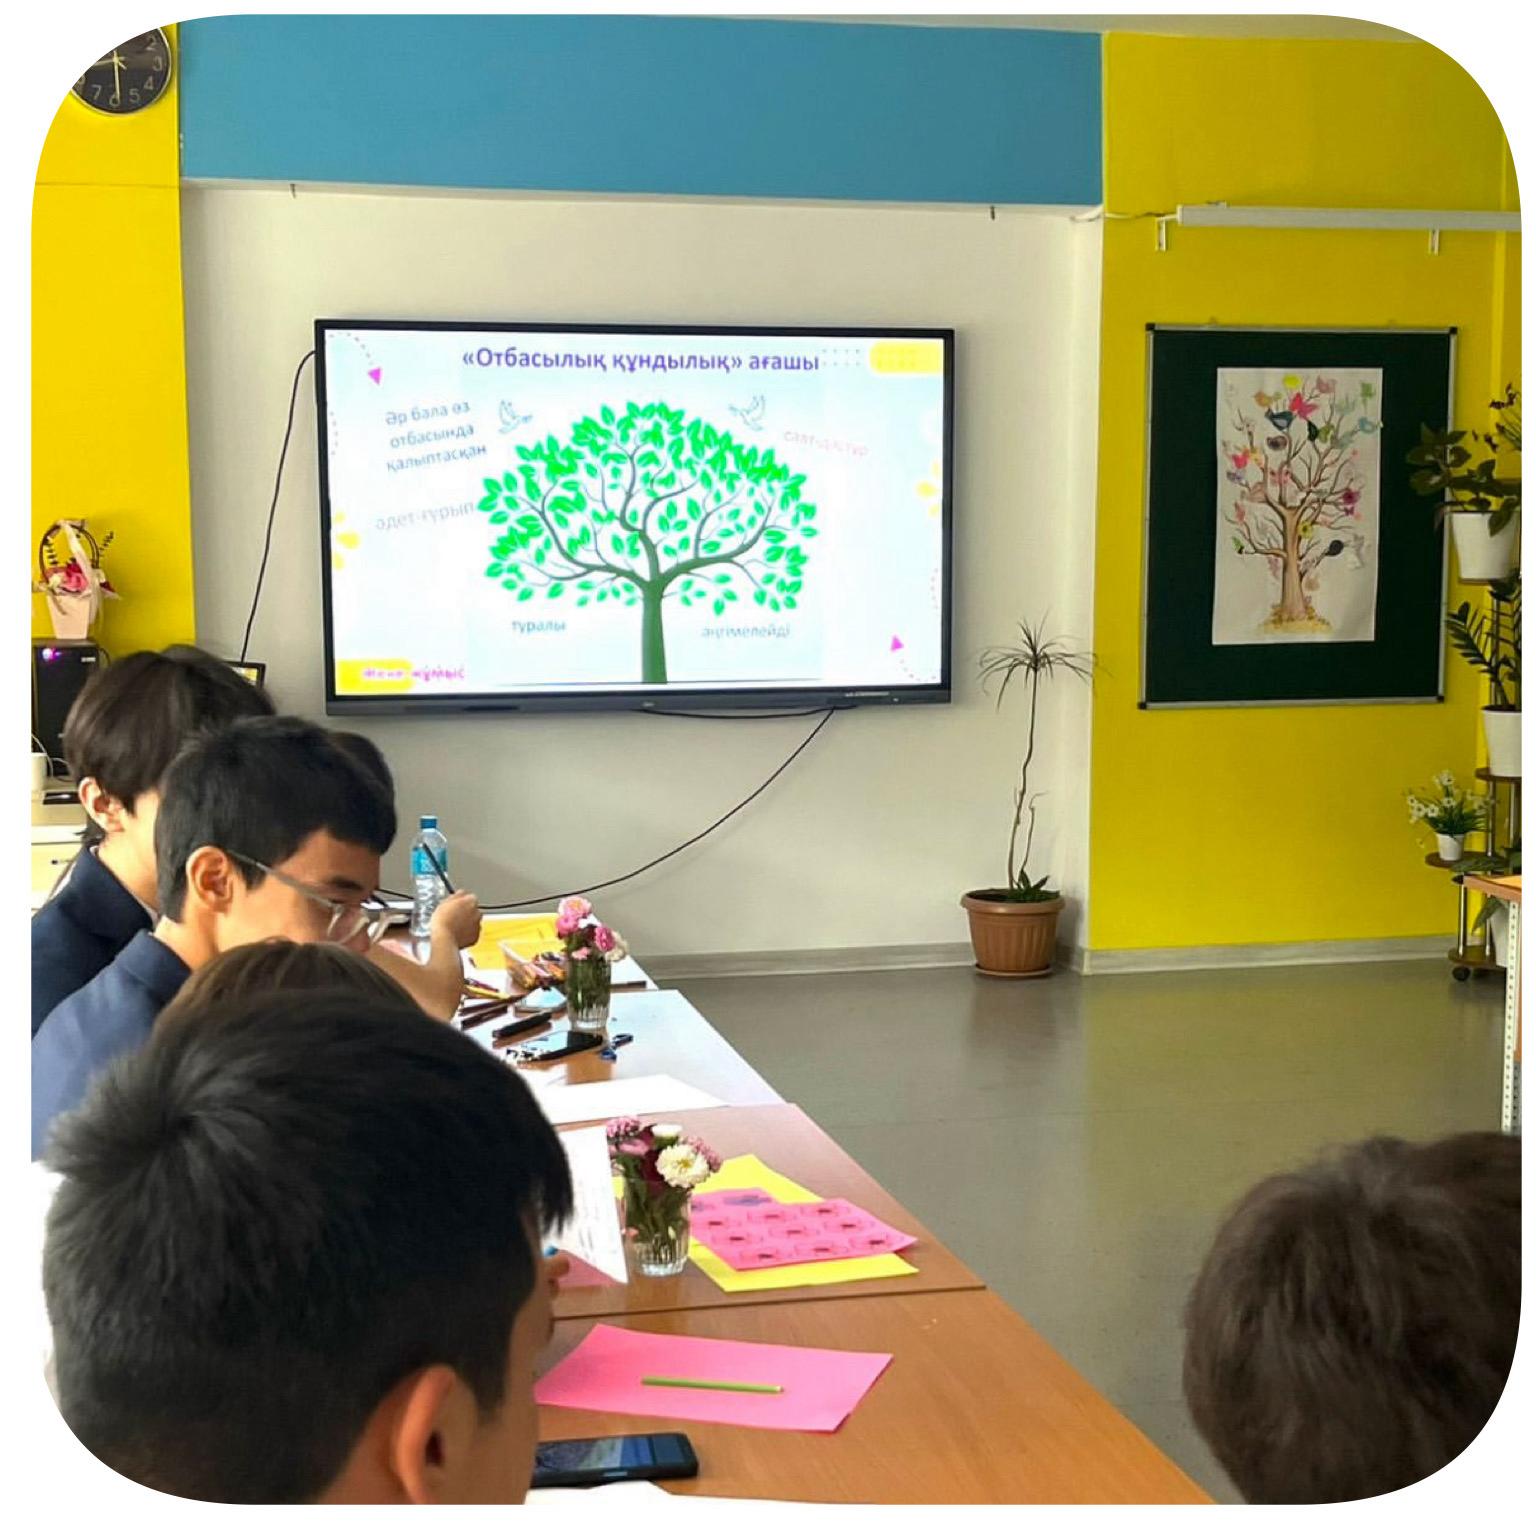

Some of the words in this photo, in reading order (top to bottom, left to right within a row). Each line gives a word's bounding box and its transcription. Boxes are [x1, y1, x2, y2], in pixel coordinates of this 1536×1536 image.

[91, 84, 102, 101] 7
[144, 76, 154, 90] 4
[128, 88, 140, 103] 5
[462, 347, 607, 372] «Отбасылық
[612, 356, 743, 373] құндылық»
[749, 354, 820, 371] ағашы
[385, 411, 408, 426] Әр
[411, 406, 449, 422] бала
[390, 424, 474, 449] отбасында
[386, 444, 487, 473] қалыптасқан
